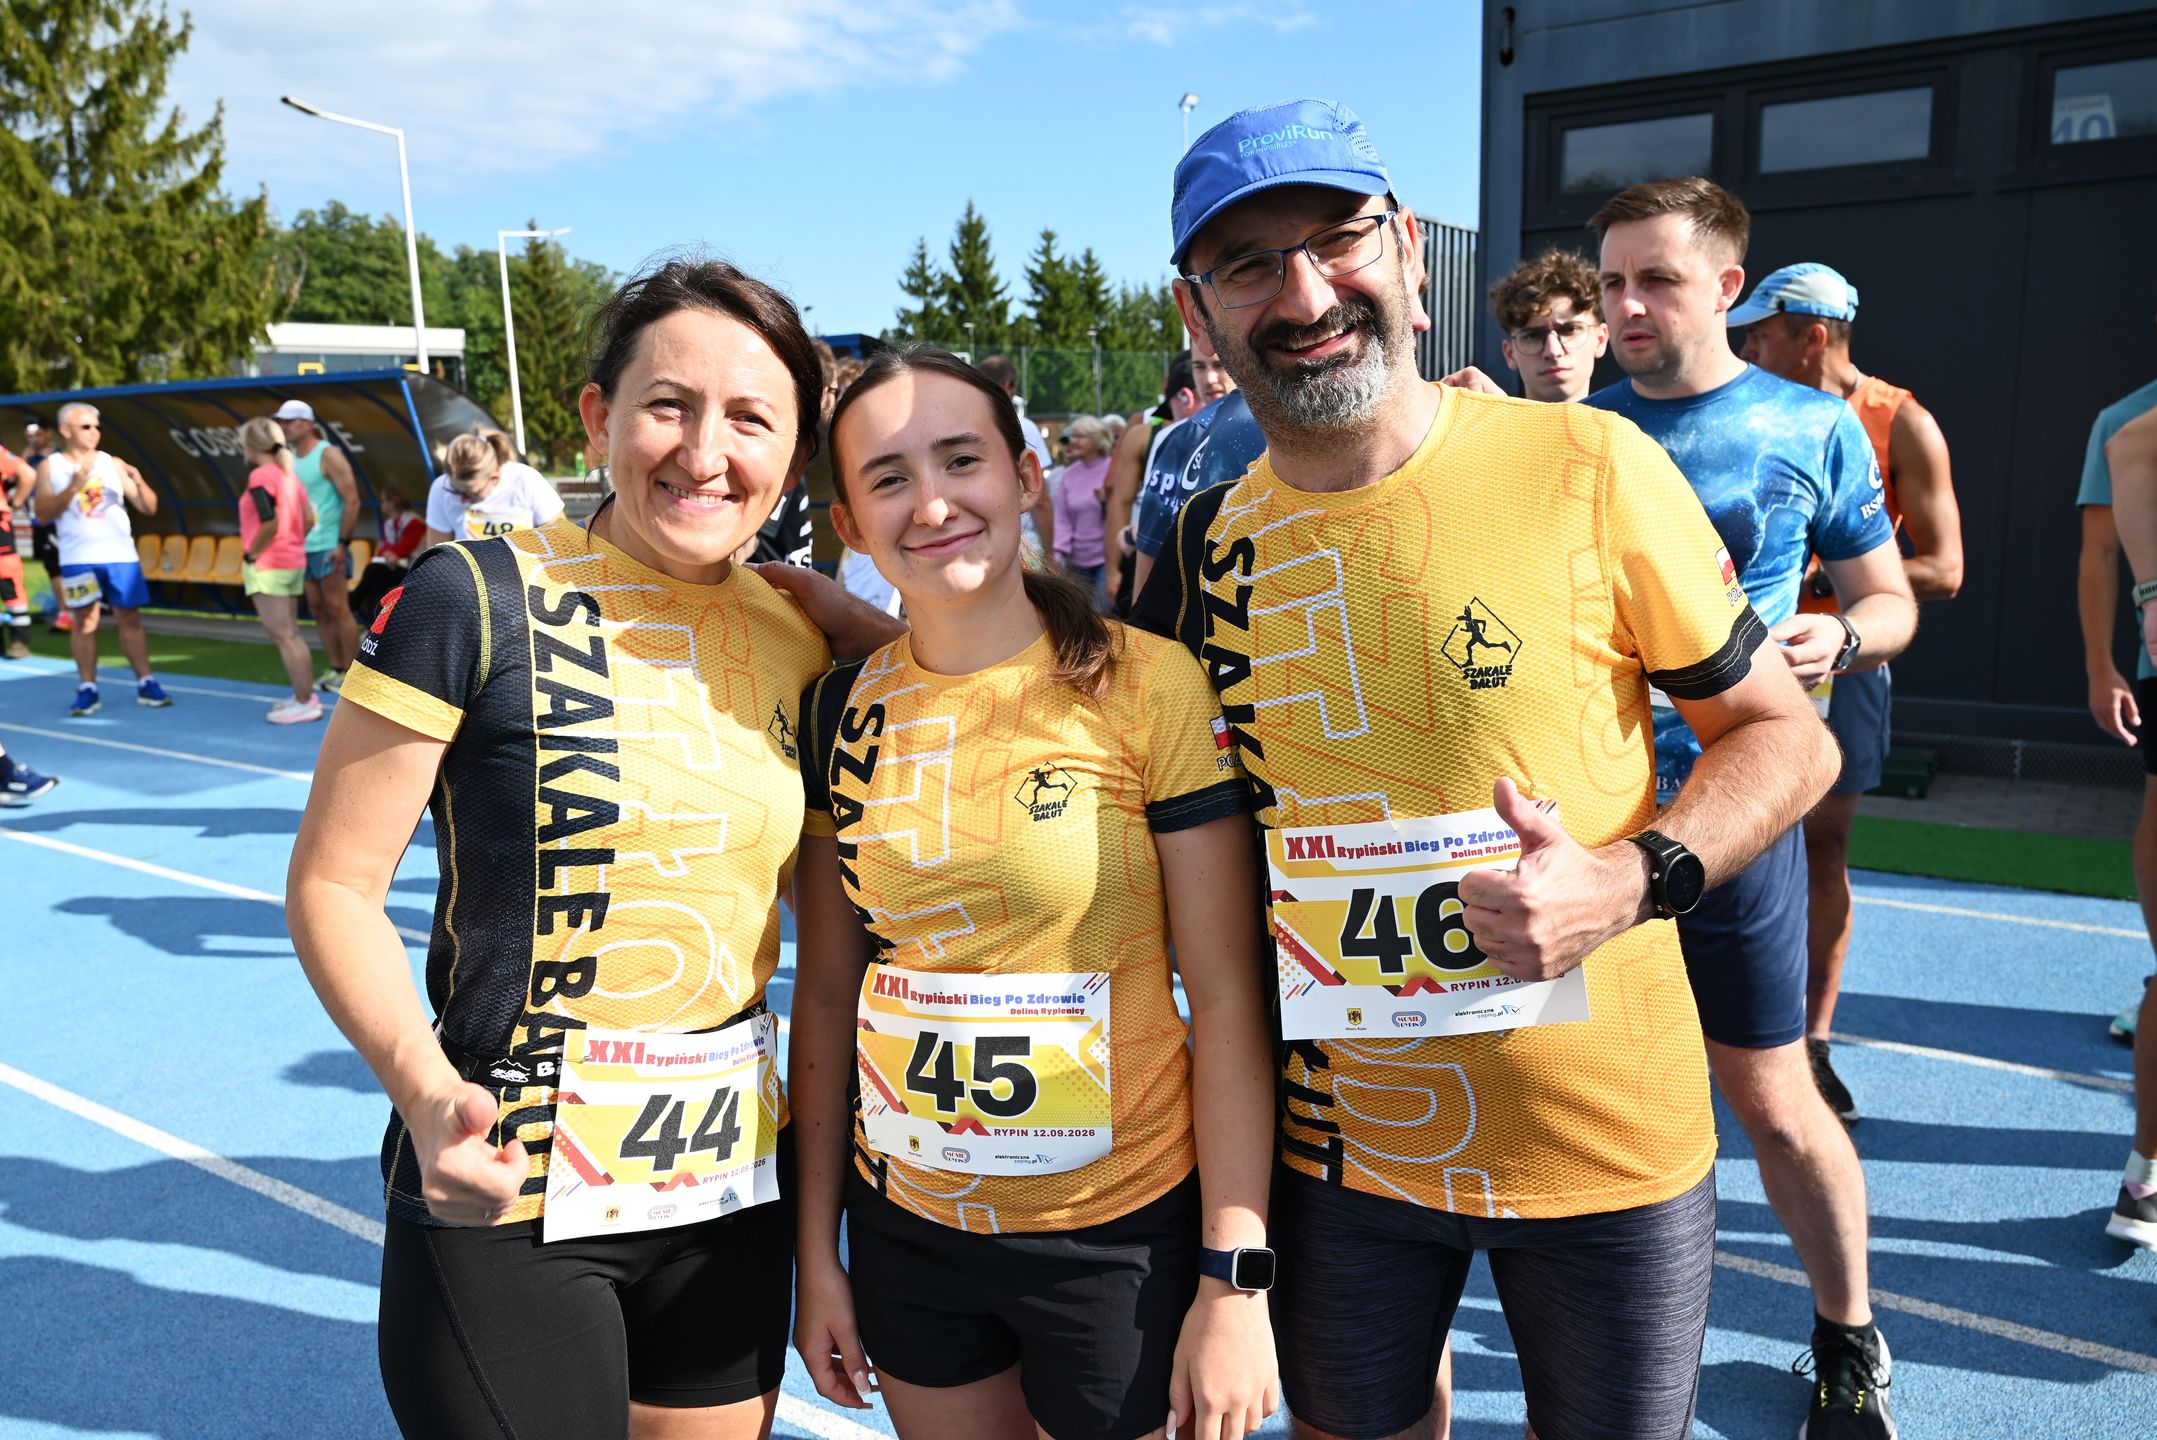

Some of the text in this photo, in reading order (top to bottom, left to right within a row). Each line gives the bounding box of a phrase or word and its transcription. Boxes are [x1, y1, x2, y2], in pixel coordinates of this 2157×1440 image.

[1239, 124, 1334, 152] ProviRun
[361, 636, 379, 656] ÓDŹ
[1463, 665, 1513, 679] SZAKALE
[1470, 677, 1507, 690] BAŁUT
[527, 583, 621, 936] SZAKALE
[1029, 800, 1068, 815] SZAKALE
[1033, 809, 1063, 821] BAŁUT
[1286, 829, 1517, 859] XXI Rypiński Bieg Po Zdrow
[1485, 841, 1521, 855] Rypieni
[1341, 881, 1488, 973] 46
[873, 973, 1085, 1006] XXI Rypiński Bieg Po Zdrowie
[1451, 979, 1490, 991] RYPIN
[1041, 1007, 1085, 1015] Rypienicy
[589, 1040, 645, 1064] XXI
[646, 1052, 707, 1067] Rypiński
[709, 1048, 729, 1061] Bieg
[906, 1031, 1036, 1117] 45
[620, 1086, 741, 1171] 44
[1033, 1129, 1095, 1137] 12.09.2026
[703, 1172, 728, 1184] RYPIN
